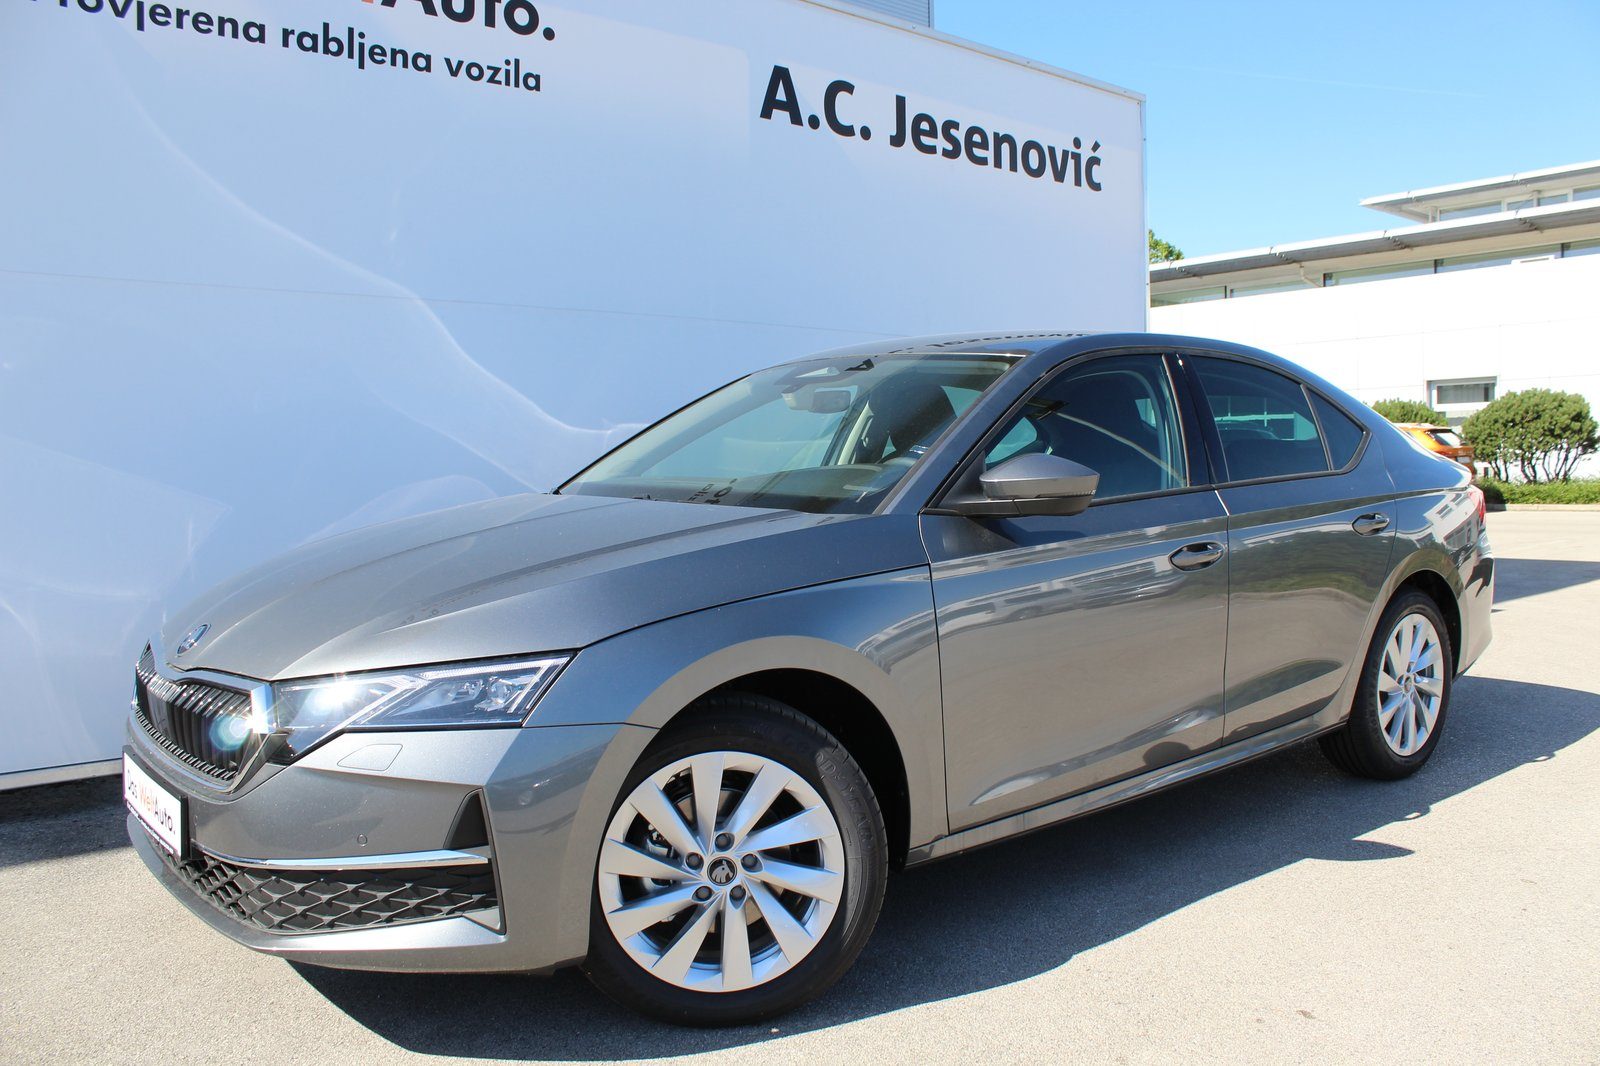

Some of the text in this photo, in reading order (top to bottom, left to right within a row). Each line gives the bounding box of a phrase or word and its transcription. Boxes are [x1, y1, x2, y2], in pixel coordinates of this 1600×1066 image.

[29, 0, 542, 92] ovjerena rabljena vozila
[381, 0, 556, 42] uto.
[759, 64, 1102, 192] A.C. Jesenović
